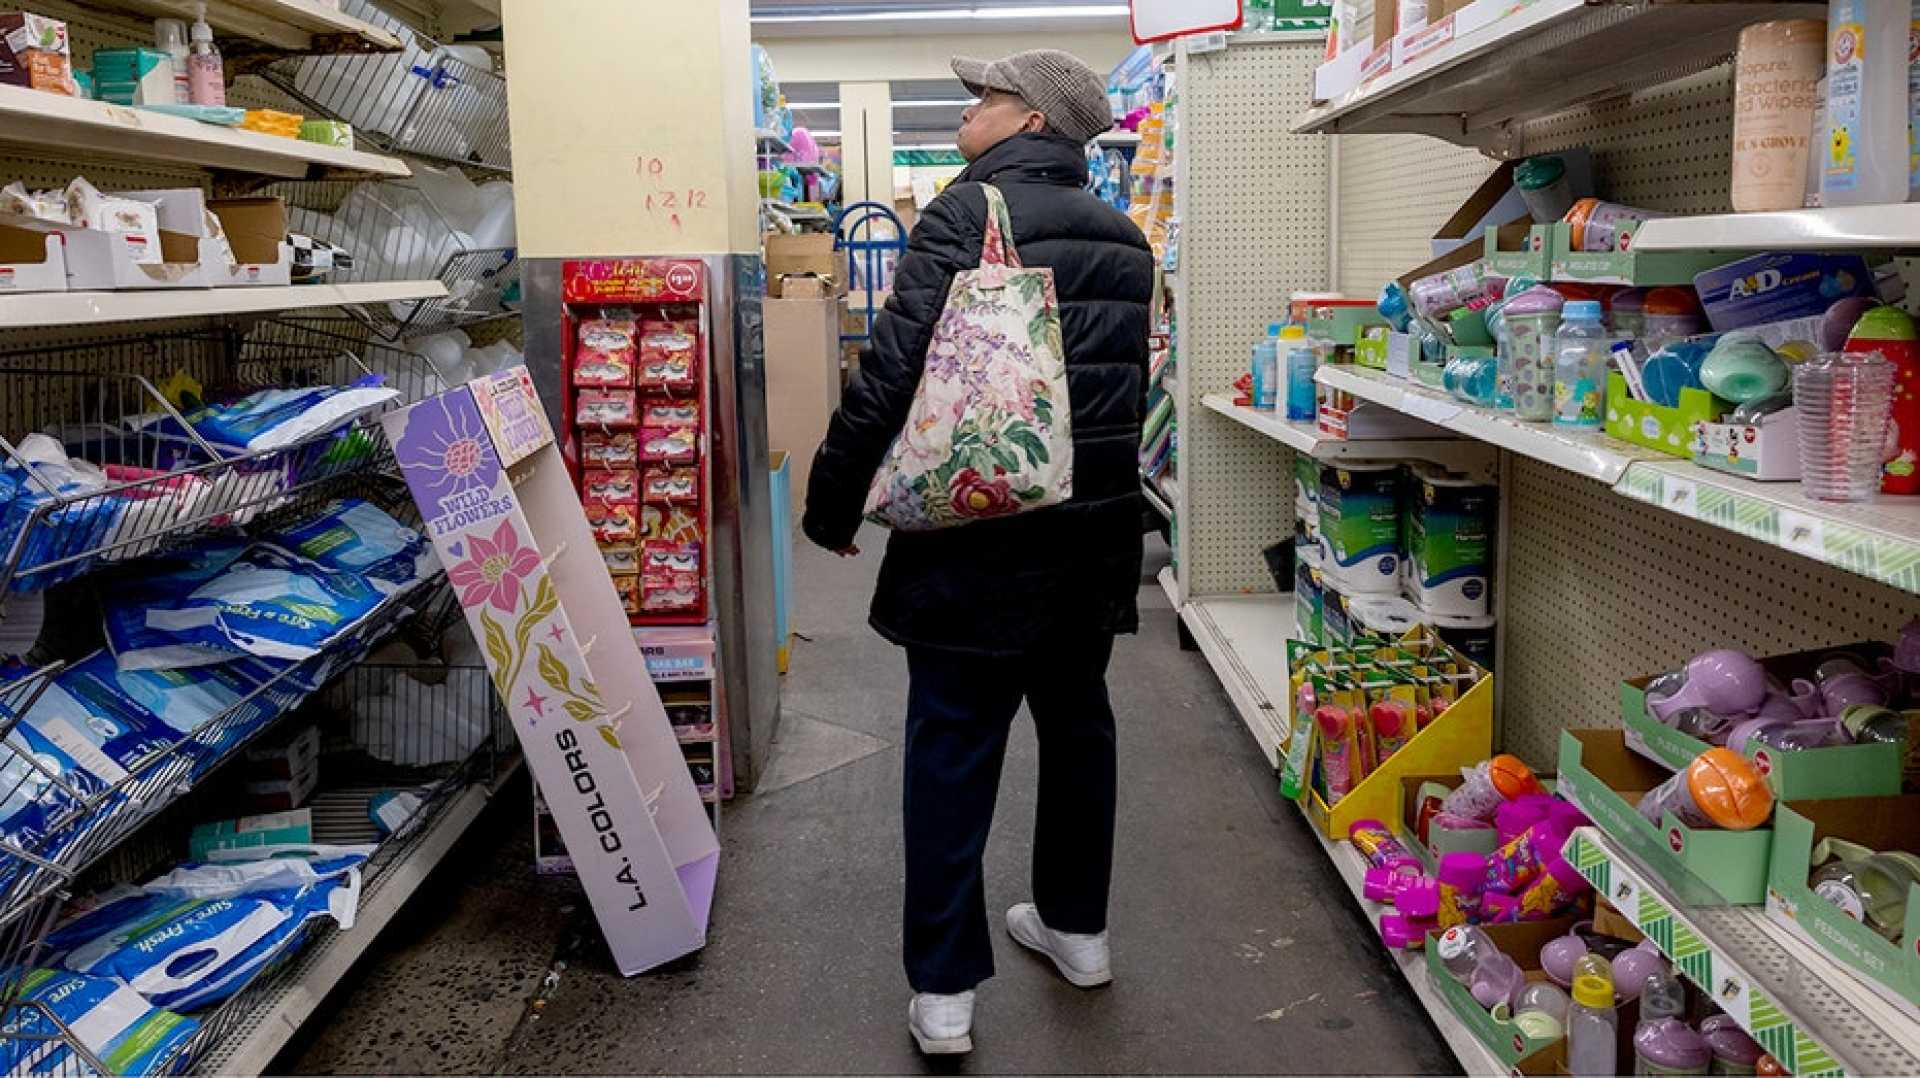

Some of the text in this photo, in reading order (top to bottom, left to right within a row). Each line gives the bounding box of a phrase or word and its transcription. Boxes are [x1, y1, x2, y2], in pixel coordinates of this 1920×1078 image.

[433, 494, 513, 535] FLOWERS
[439, 487, 490, 516] WILD
[556, 728, 622, 854] COLORS
[616, 856, 648, 912] L.A.
[134, 923, 183, 953] Fresh
